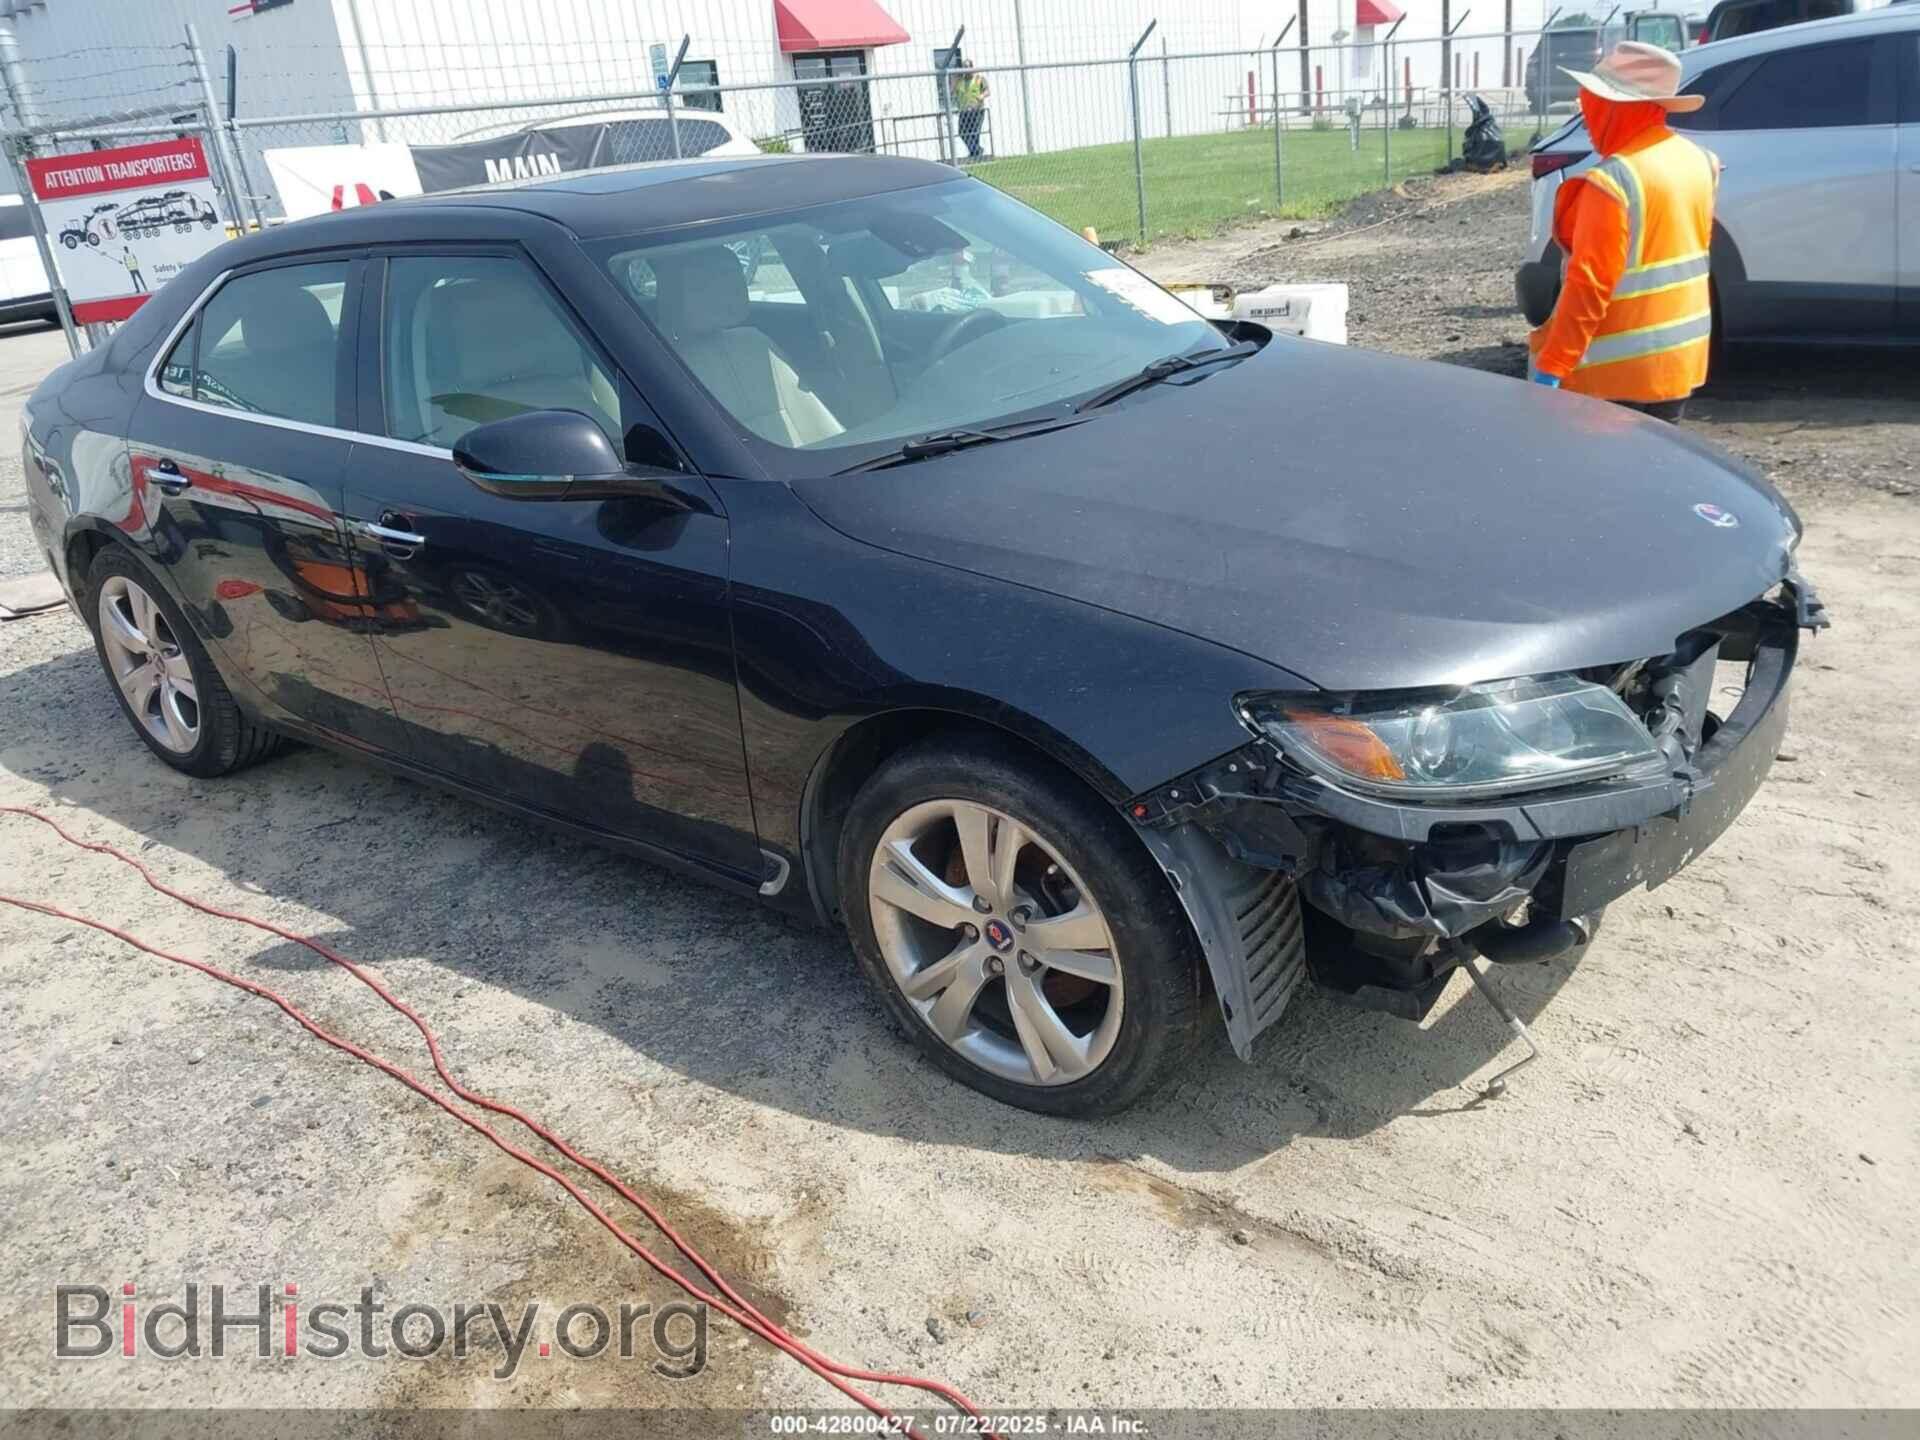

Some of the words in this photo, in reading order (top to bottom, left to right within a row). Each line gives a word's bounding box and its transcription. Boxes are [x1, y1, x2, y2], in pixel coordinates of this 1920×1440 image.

[44, 166, 104, 189] ATTENTION
[104, 152, 197, 181] TRANSPORTERS!
[484, 152, 561, 184] MAIN
